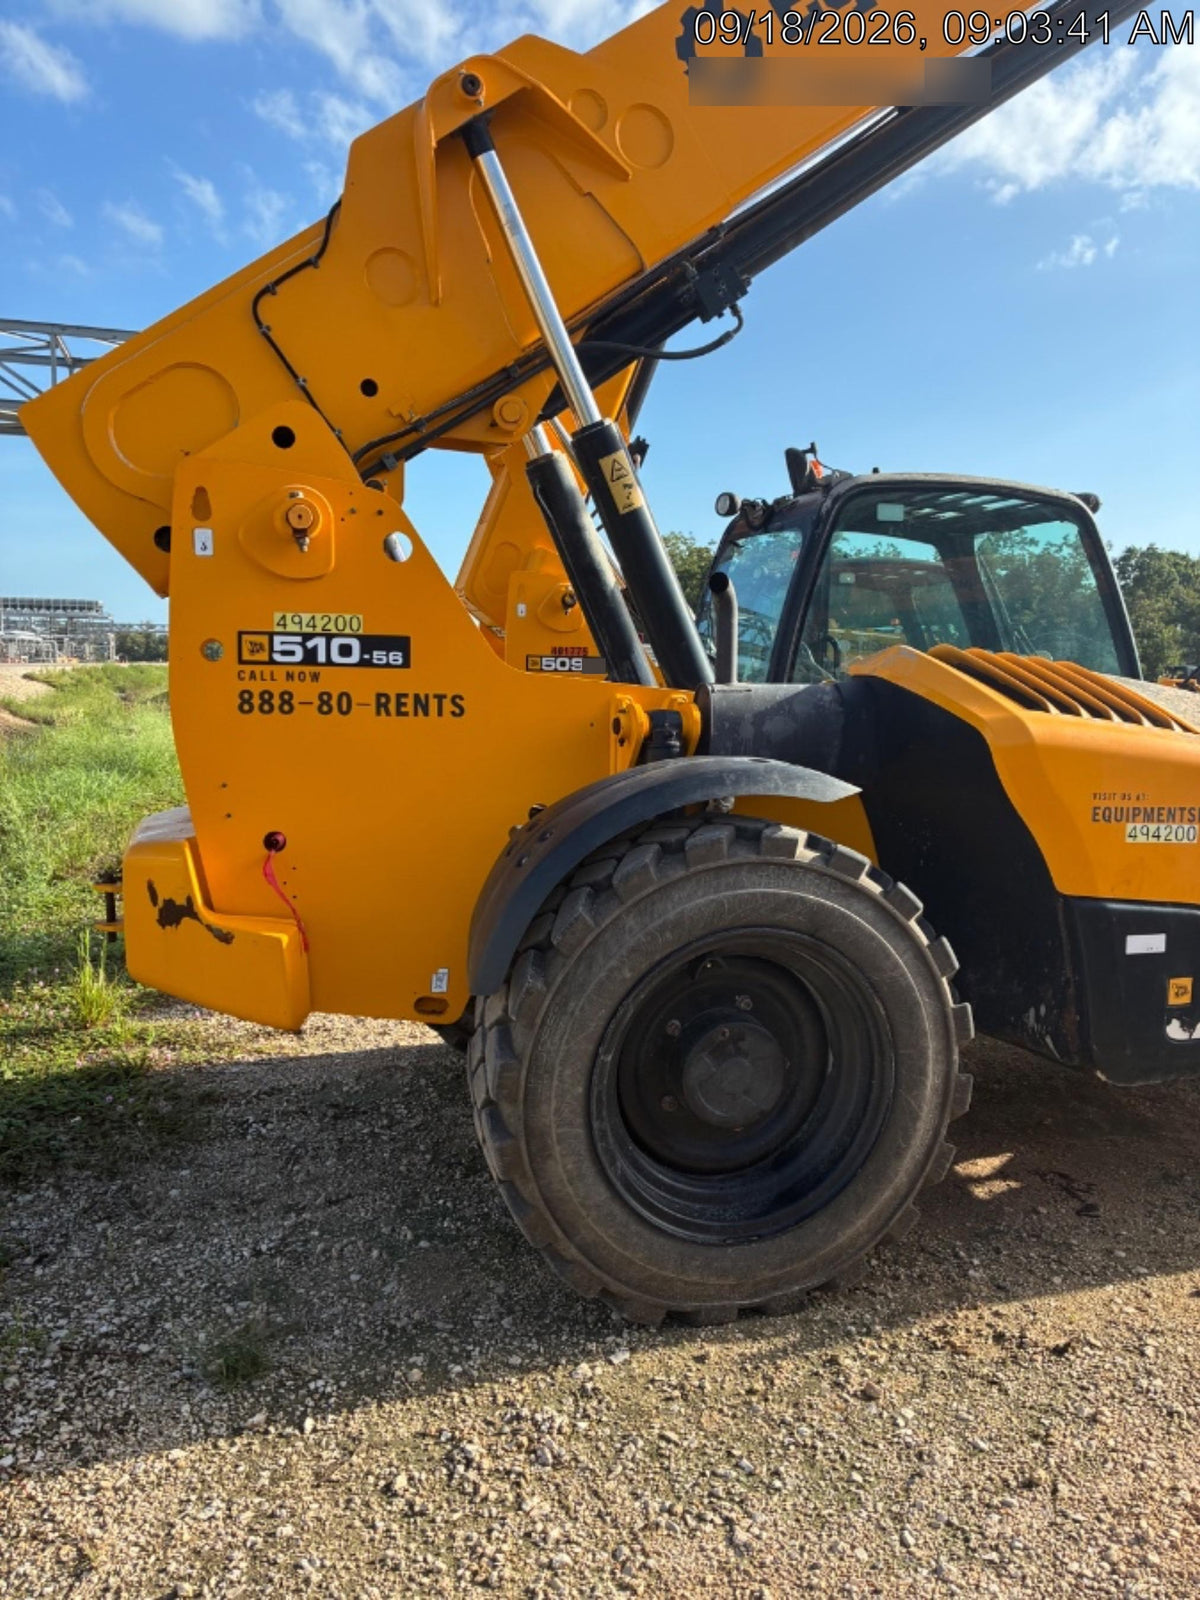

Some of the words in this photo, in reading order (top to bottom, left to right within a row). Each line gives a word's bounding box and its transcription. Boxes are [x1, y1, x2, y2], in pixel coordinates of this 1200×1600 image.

[276, 614, 362, 632] 494200
[237, 670, 278, 682] CALL
[285, 671, 321, 683] NOW
[237, 689, 466, 718] 888-80-RENTS
[1092, 792, 1117, 801] VISIT
[1091, 806, 1200, 824] EQUIPMENTS
[1127, 824, 1197, 842] 494200
